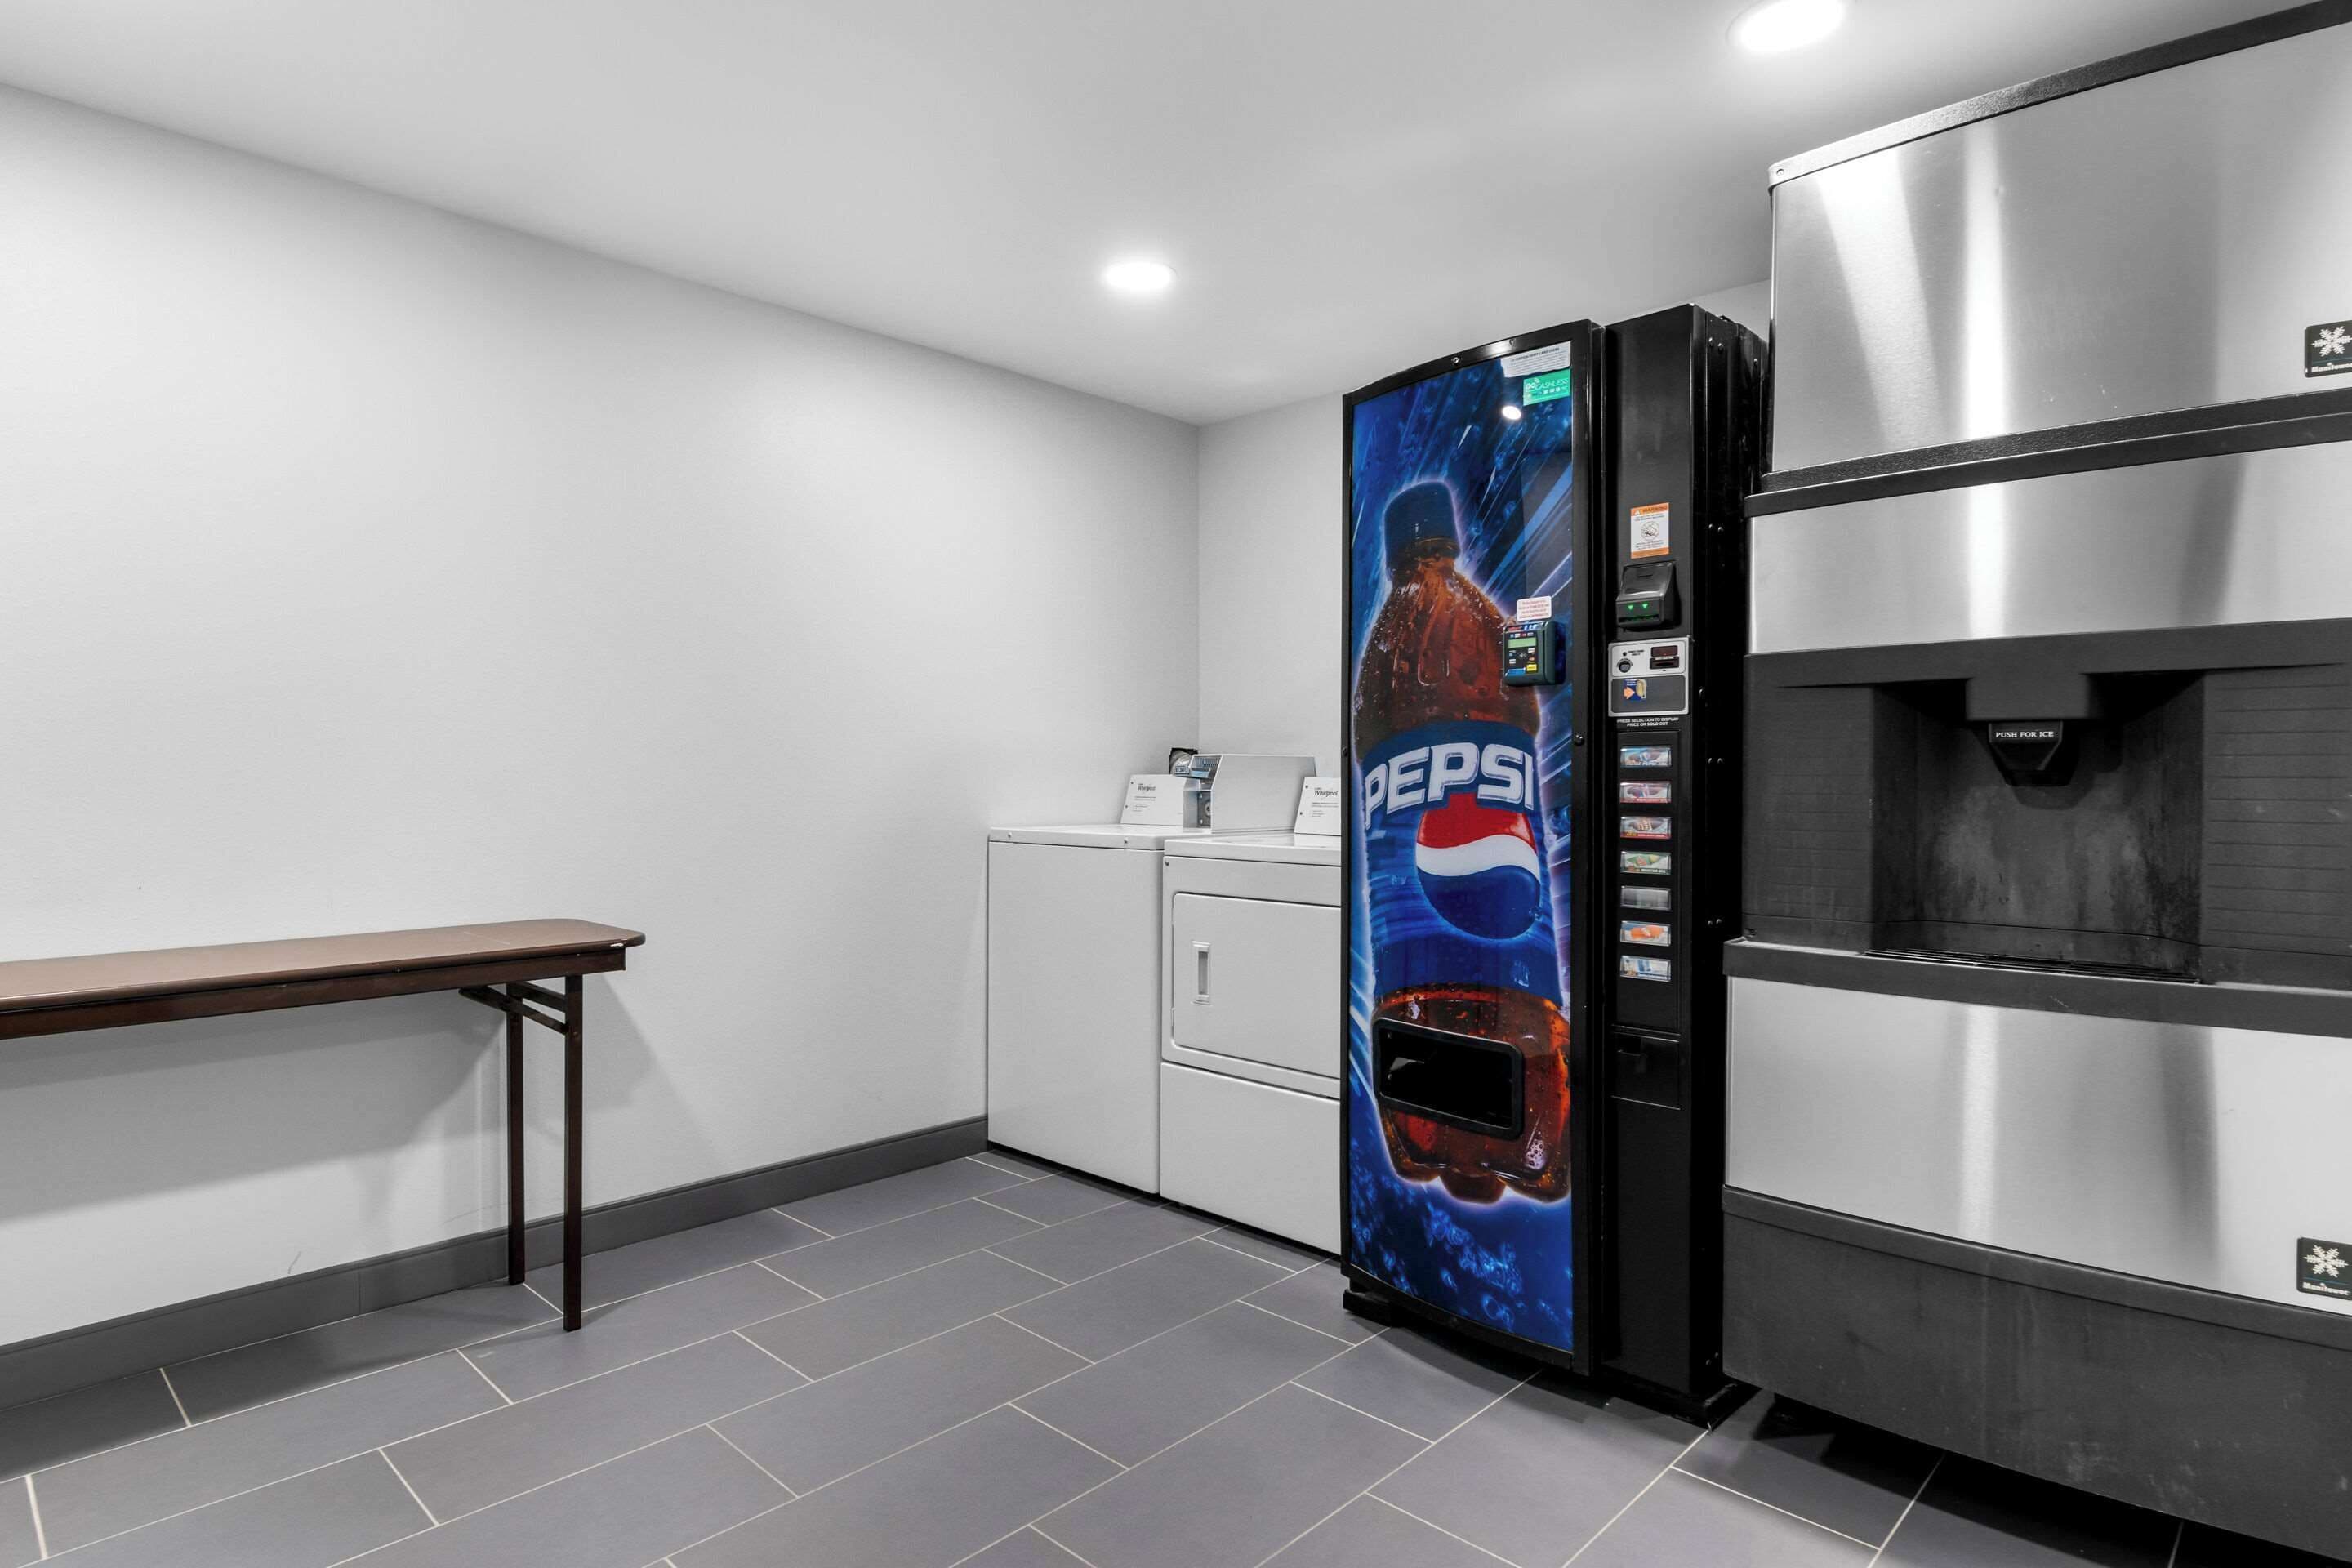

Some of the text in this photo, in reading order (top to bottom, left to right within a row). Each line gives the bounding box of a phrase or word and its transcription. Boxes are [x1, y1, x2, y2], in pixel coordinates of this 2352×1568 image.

[1535, 378, 1569, 390] CASHLESS
[1365, 742, 1535, 831] PEPSI
[1315, 790, 1338, 798] Whirlpool
[2303, 1282, 2350, 1295] Manitowoc
